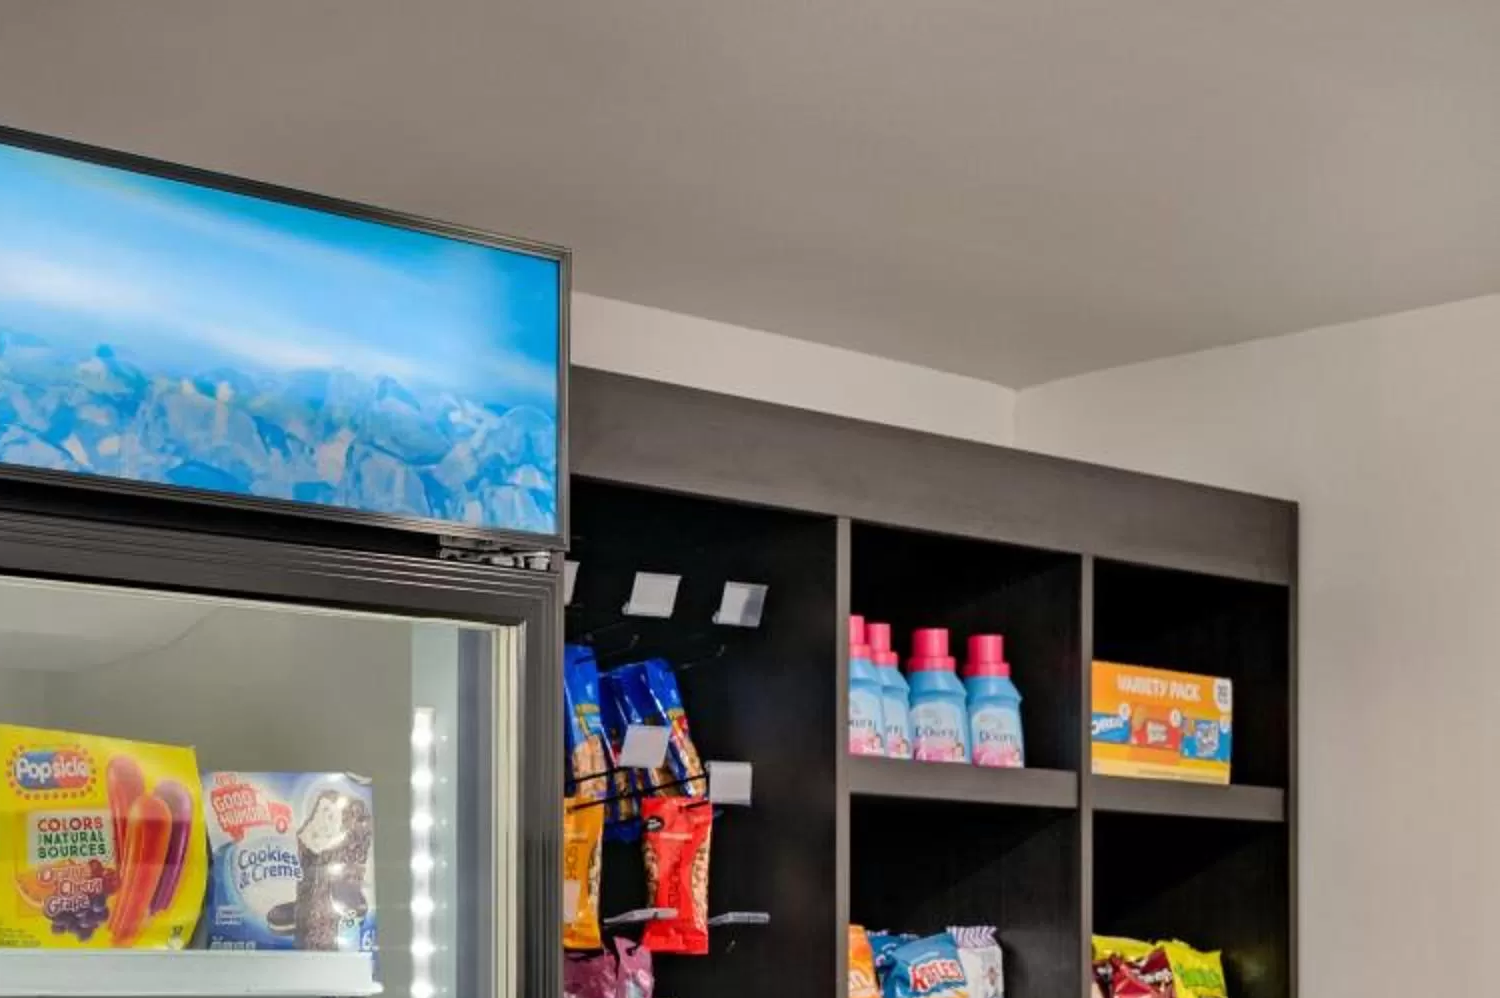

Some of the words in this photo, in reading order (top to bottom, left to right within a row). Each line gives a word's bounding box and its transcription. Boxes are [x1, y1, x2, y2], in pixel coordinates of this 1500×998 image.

[37, 817, 104, 832] COLORS
[43, 832, 104, 845] NATURAL
[37, 844, 106, 859] SOURCES
[238, 843, 299, 869] Cookies
[251, 862, 303, 882] Creme
